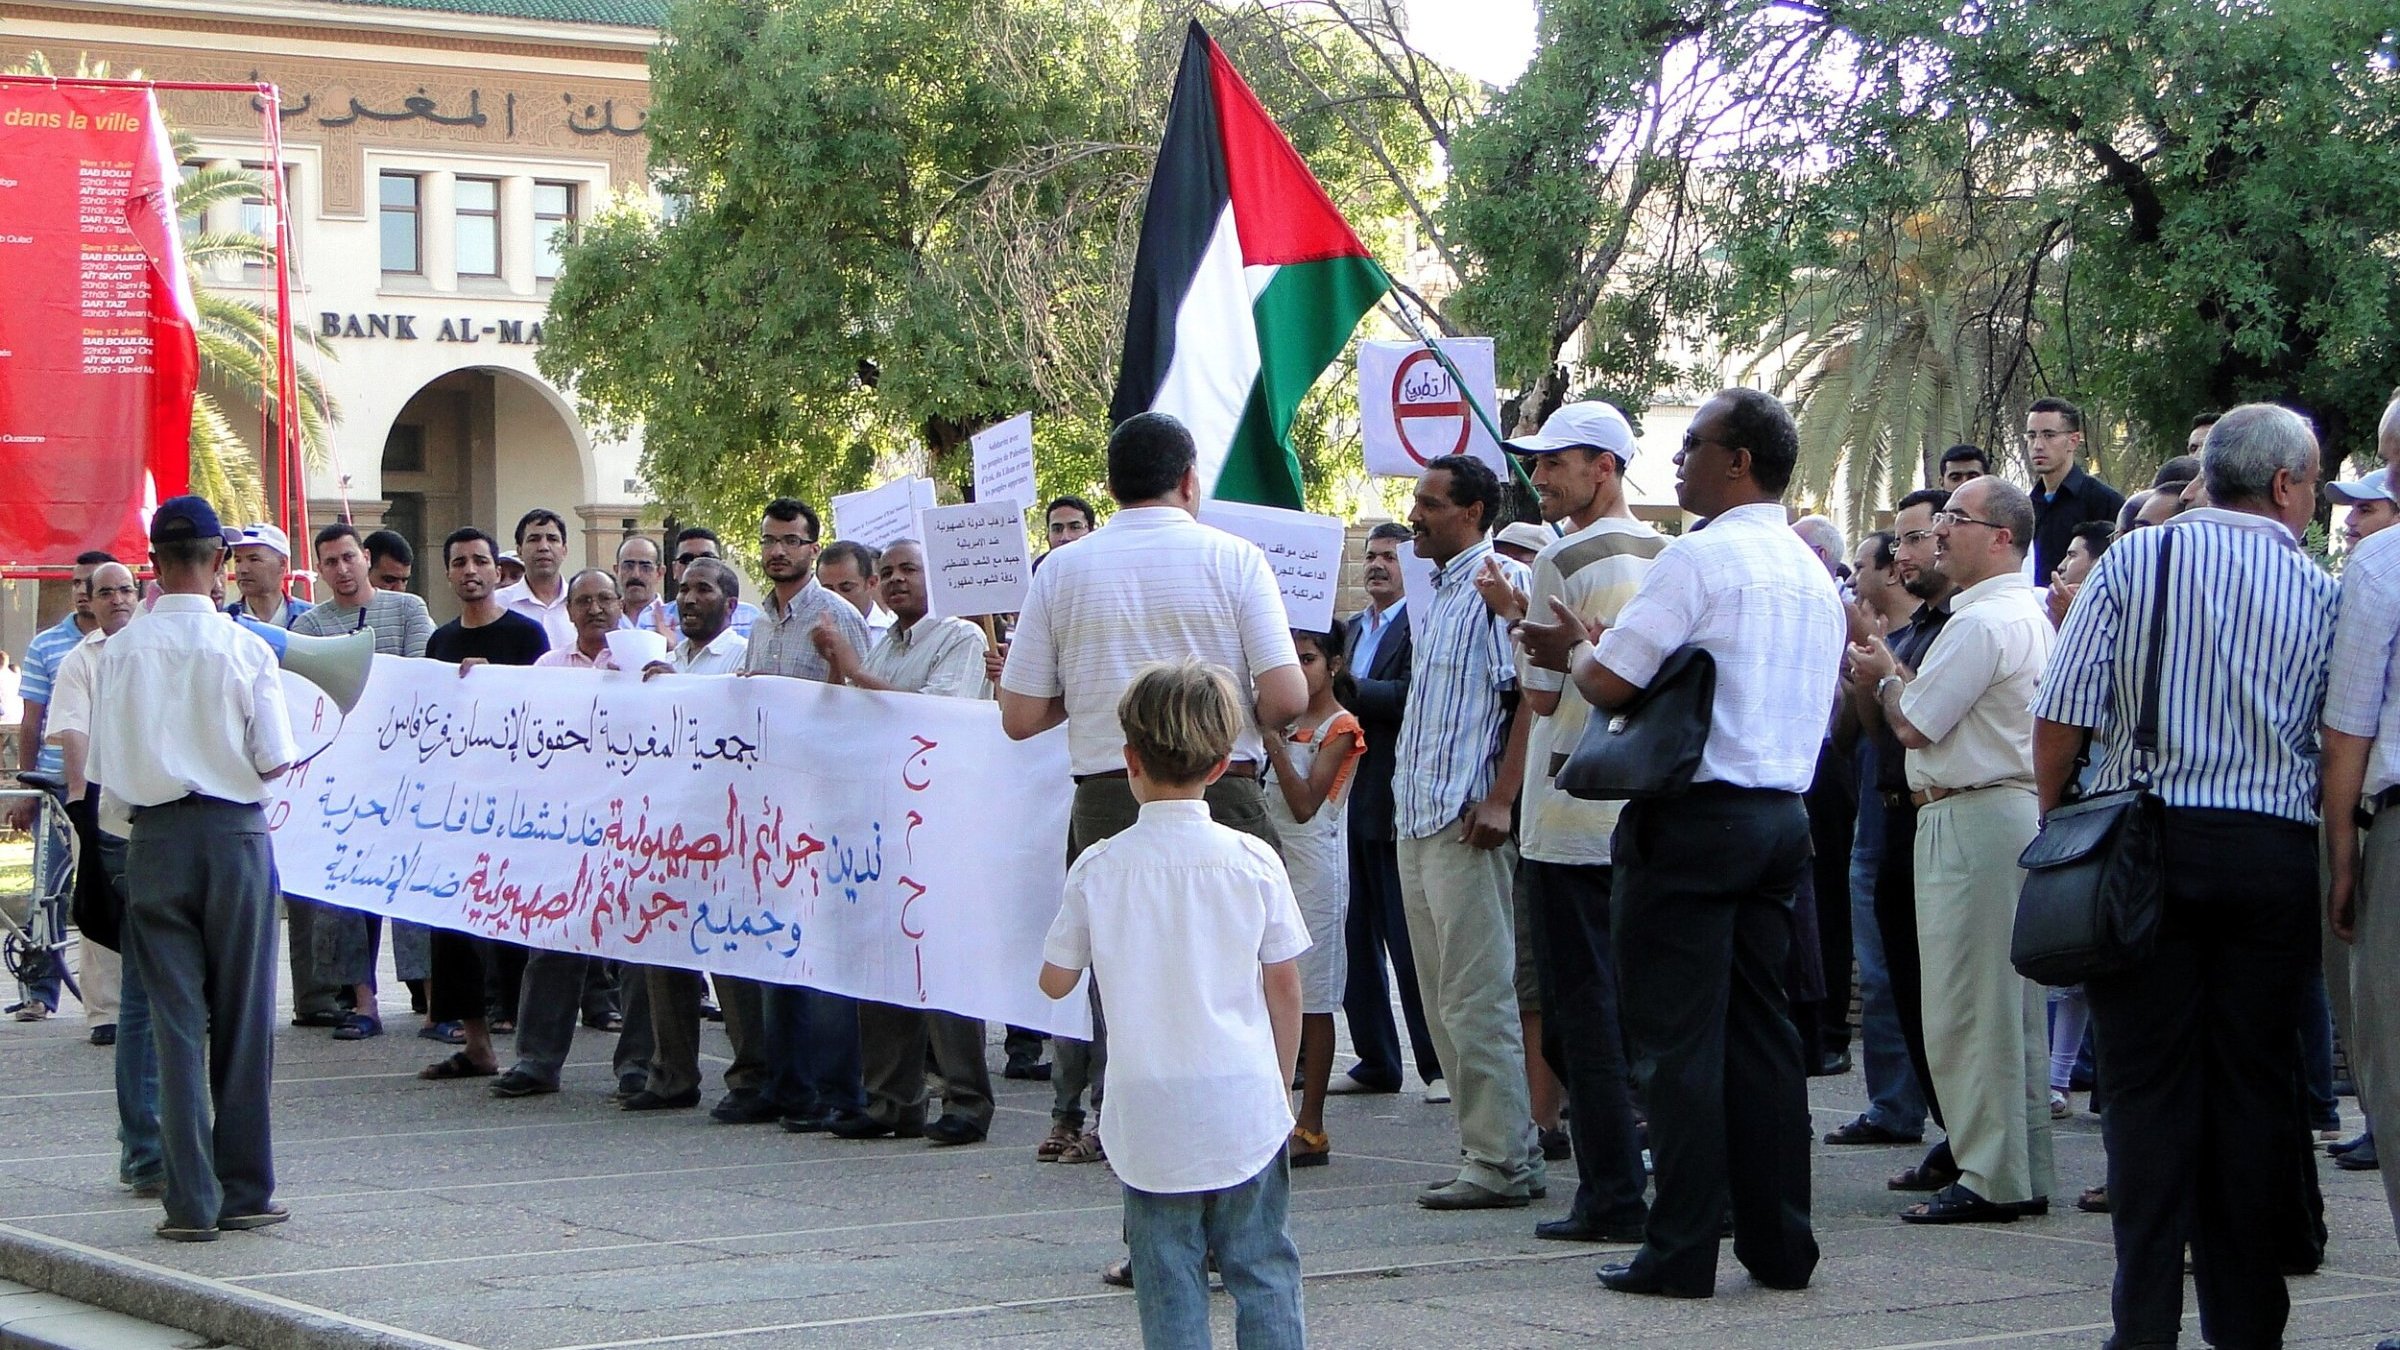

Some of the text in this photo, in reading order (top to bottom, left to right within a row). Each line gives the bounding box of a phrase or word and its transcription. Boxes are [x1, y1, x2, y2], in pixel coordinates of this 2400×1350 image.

[4, 107, 140, 132] dans la ville
[80, 168, 99, 176] BAB
[80, 215, 101, 223] DAR
[81, 253, 102, 261] BAB
[99, 272, 132, 280] SKATO
[82, 300, 127, 308] DAR TAZI
[320, 312, 418, 340] BANK
[83, 338, 104, 346] BAB
[101, 356, 135, 364] SKATO
[1405, 371, 1451, 402] التطبيع
[450, 699, 530, 763] الإنسان
[526, 695, 599, 769] لحقوق
[598, 703, 684, 776] المغربية
[688, 706, 768, 770] الجمعية
[318, 775, 411, 835] الحرية
[566, 809, 604, 847] ضد
[603, 782, 748, 884] الصهيونية
[826, 820, 882, 904] ندين
